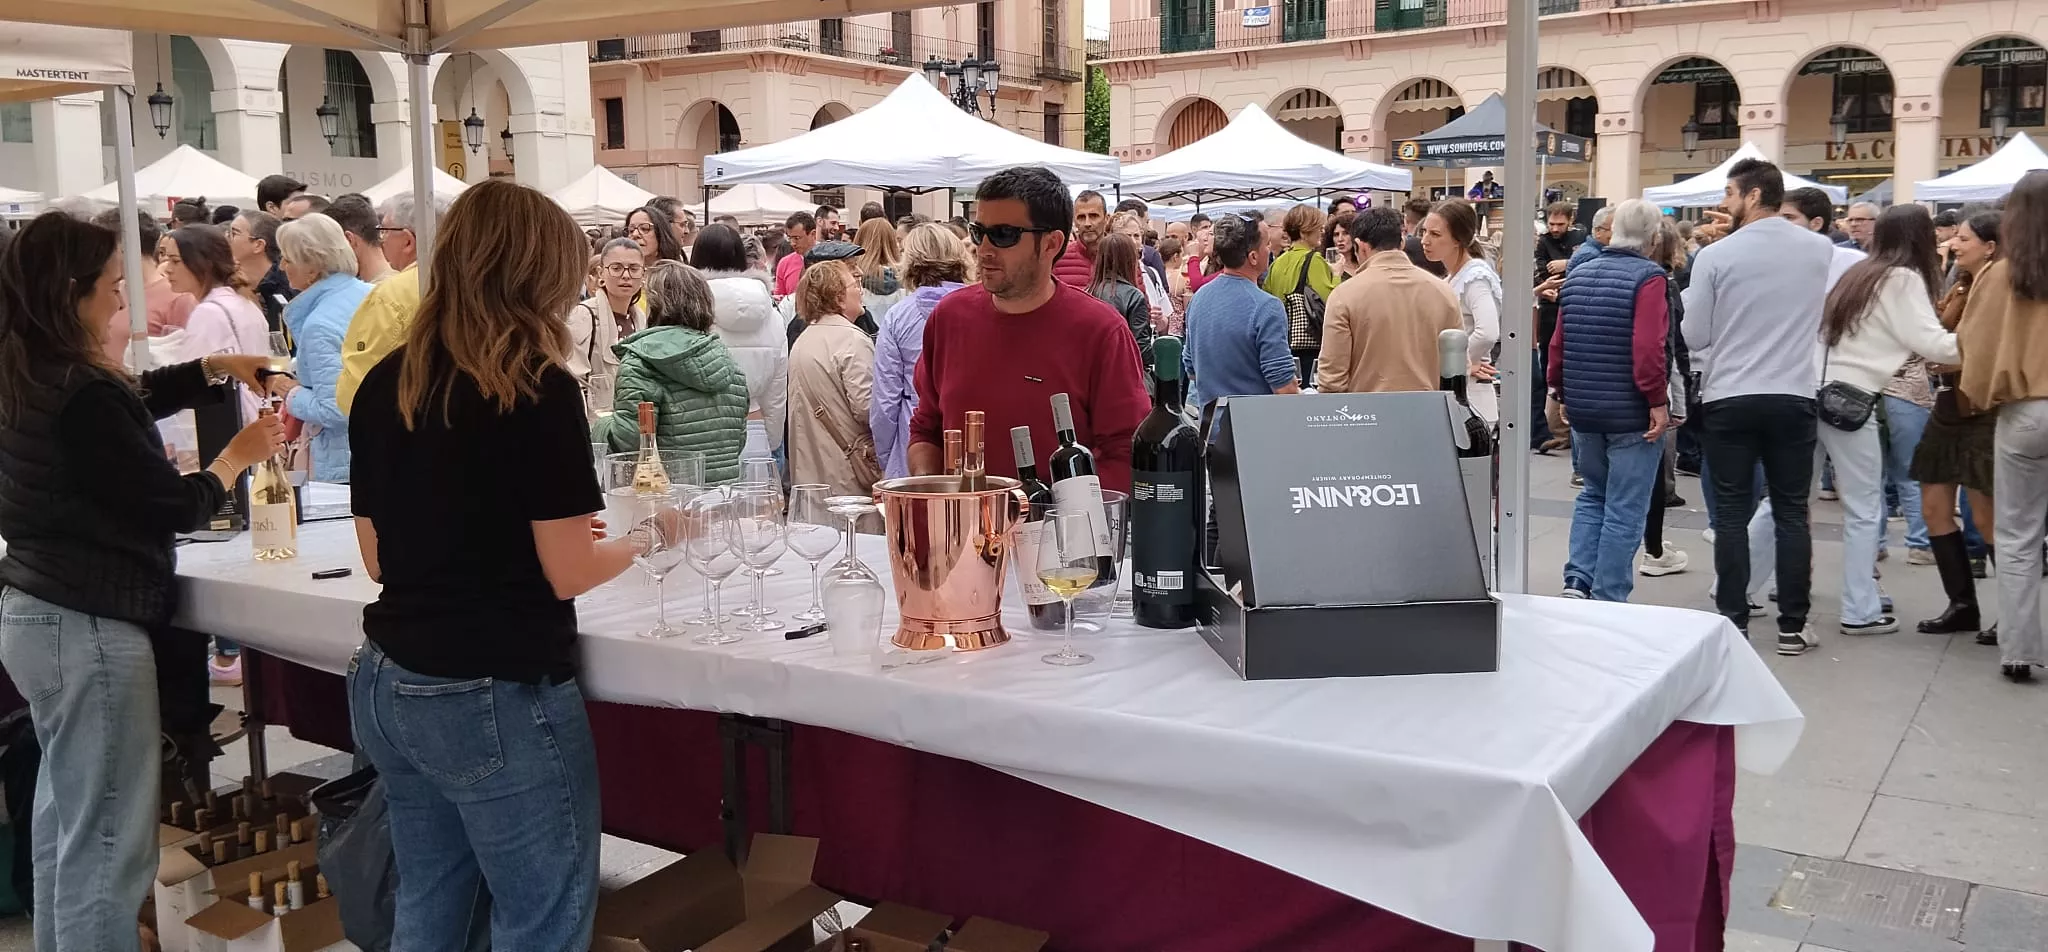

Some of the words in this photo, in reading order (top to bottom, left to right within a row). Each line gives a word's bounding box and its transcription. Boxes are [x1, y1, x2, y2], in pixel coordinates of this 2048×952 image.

[16, 68, 89, 80] MASTERTENT
[1306, 409, 1377, 421] SOMONTANO
[1289, 484, 1421, 513] LEO&NINÉ
